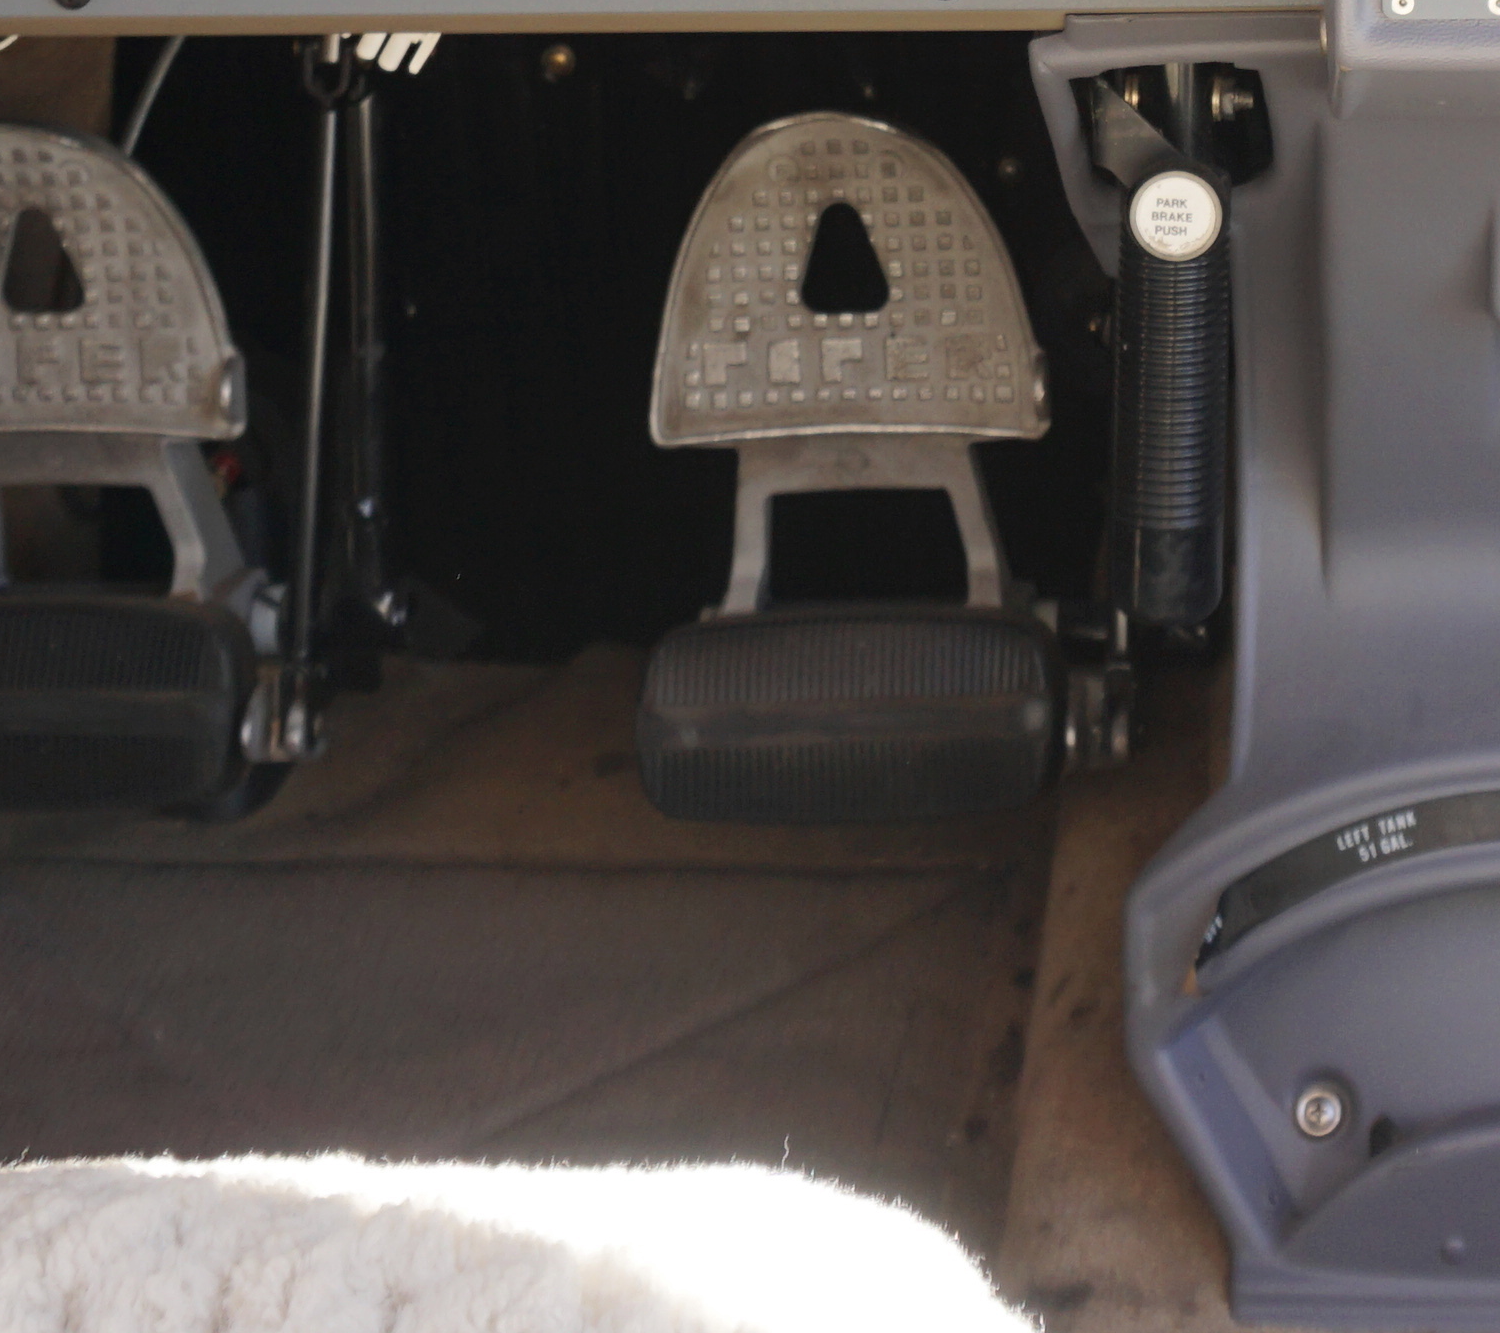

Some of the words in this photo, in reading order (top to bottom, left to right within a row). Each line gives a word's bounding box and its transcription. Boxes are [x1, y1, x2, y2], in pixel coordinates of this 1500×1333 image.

[1157, 198, 1187, 208] PARK
[1151, 212, 1192, 222] BRAKE
[1155, 225, 1187, 236] PUSH
